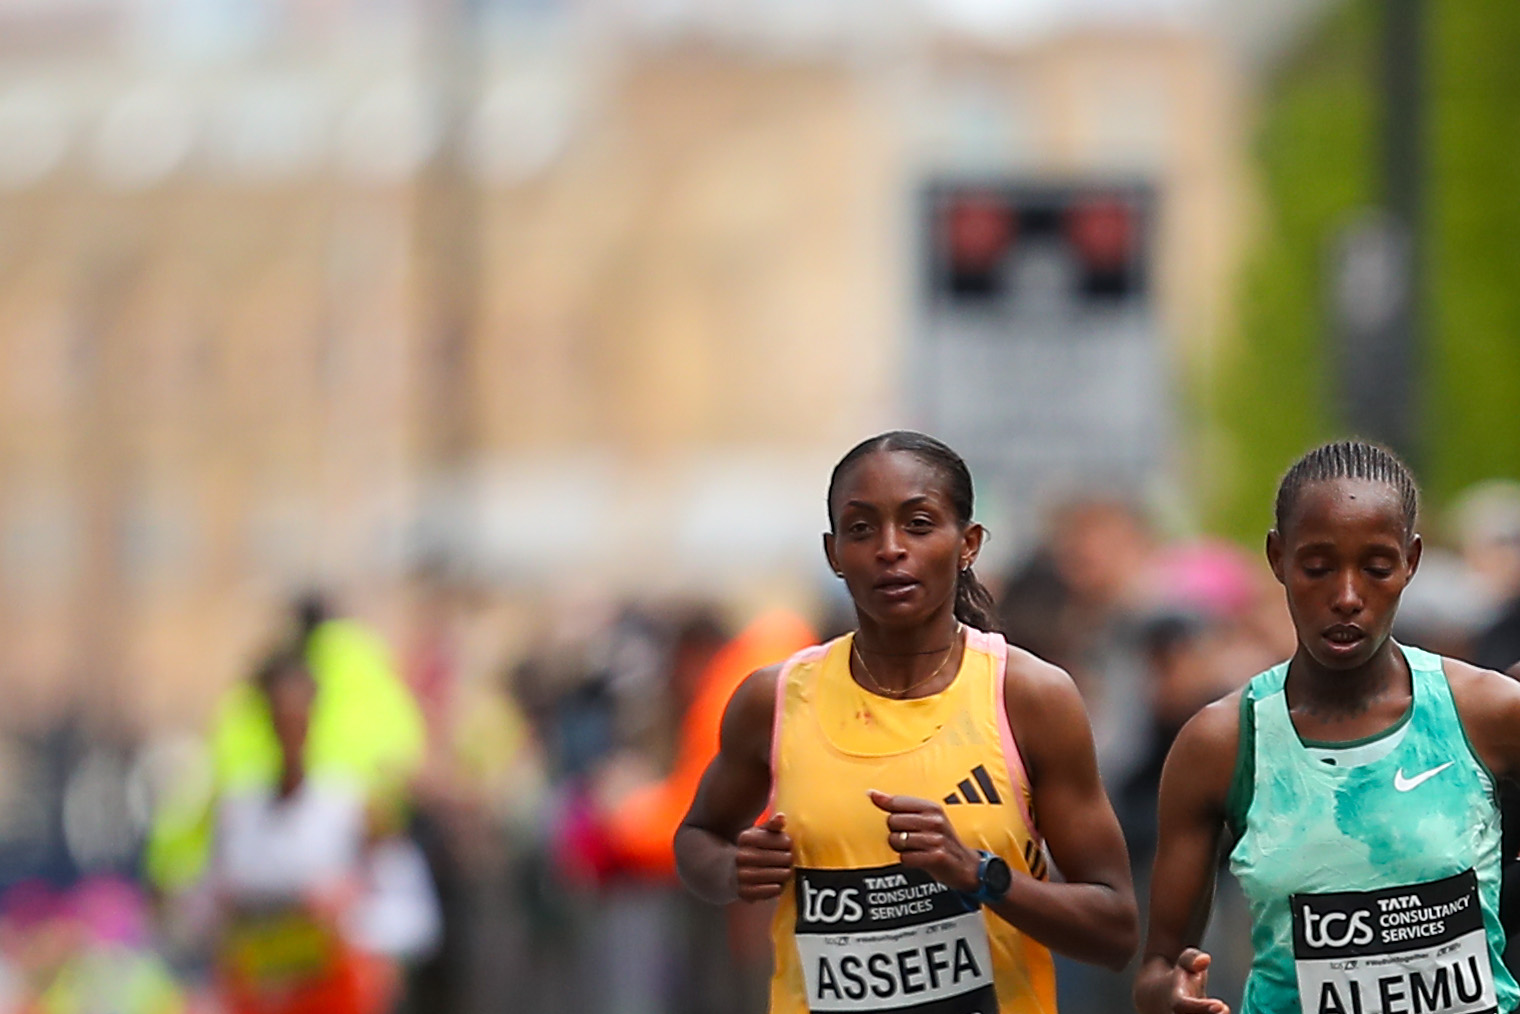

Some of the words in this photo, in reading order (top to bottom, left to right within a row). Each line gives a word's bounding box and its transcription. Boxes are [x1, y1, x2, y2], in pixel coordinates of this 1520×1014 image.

[863, 874, 908, 891] TATA
[868, 881, 949, 905] CONSULTAN
[803, 876, 863, 923] tcs
[869, 899, 933, 921] SERVICES
[1377, 895, 1422, 912] TATA
[1379, 894, 1470, 927] CONSULTANCY
[1303, 904, 1374, 947] tcs
[1381, 920, 1446, 943] SERVICES
[817, 937, 982, 1000] ASSEFA
